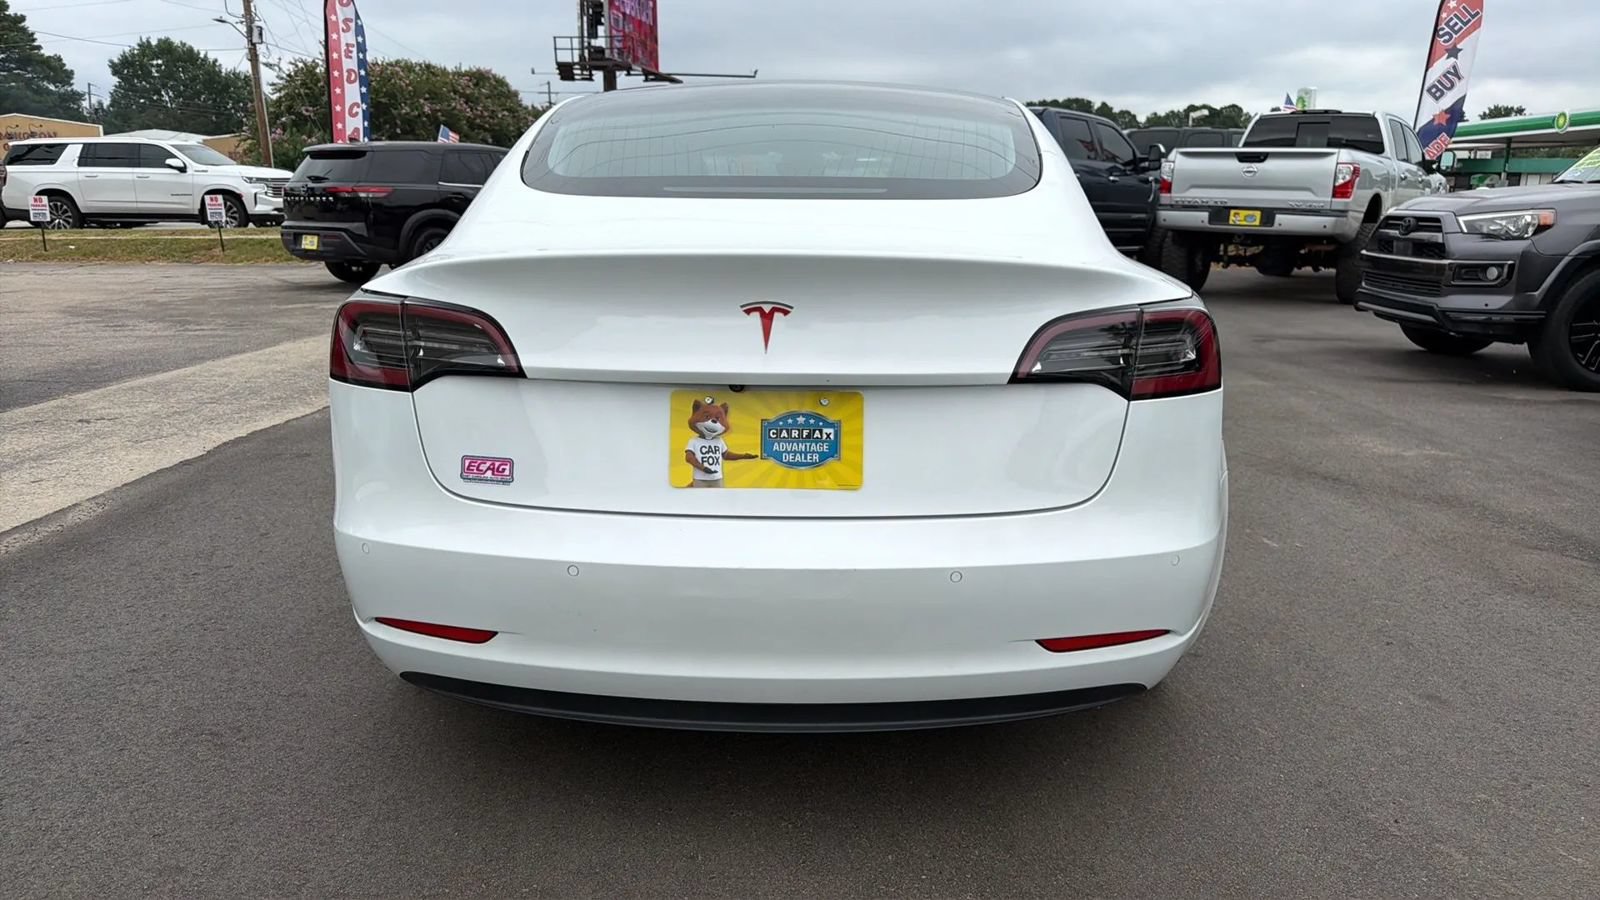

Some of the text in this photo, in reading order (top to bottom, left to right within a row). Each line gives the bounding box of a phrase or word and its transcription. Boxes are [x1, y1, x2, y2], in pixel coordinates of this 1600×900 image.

[1436, 4, 1481, 45] SELL
[1426, 61, 1463, 102] BUY
[768, 428, 834, 440] CARFAX
[699, 445, 720, 455] CAR
[773, 442, 829, 452] ADVANTAGE
[701, 456, 720, 466] FOX
[782, 453, 819, 463] DEALER
[466, 460, 508, 475] ECAG
